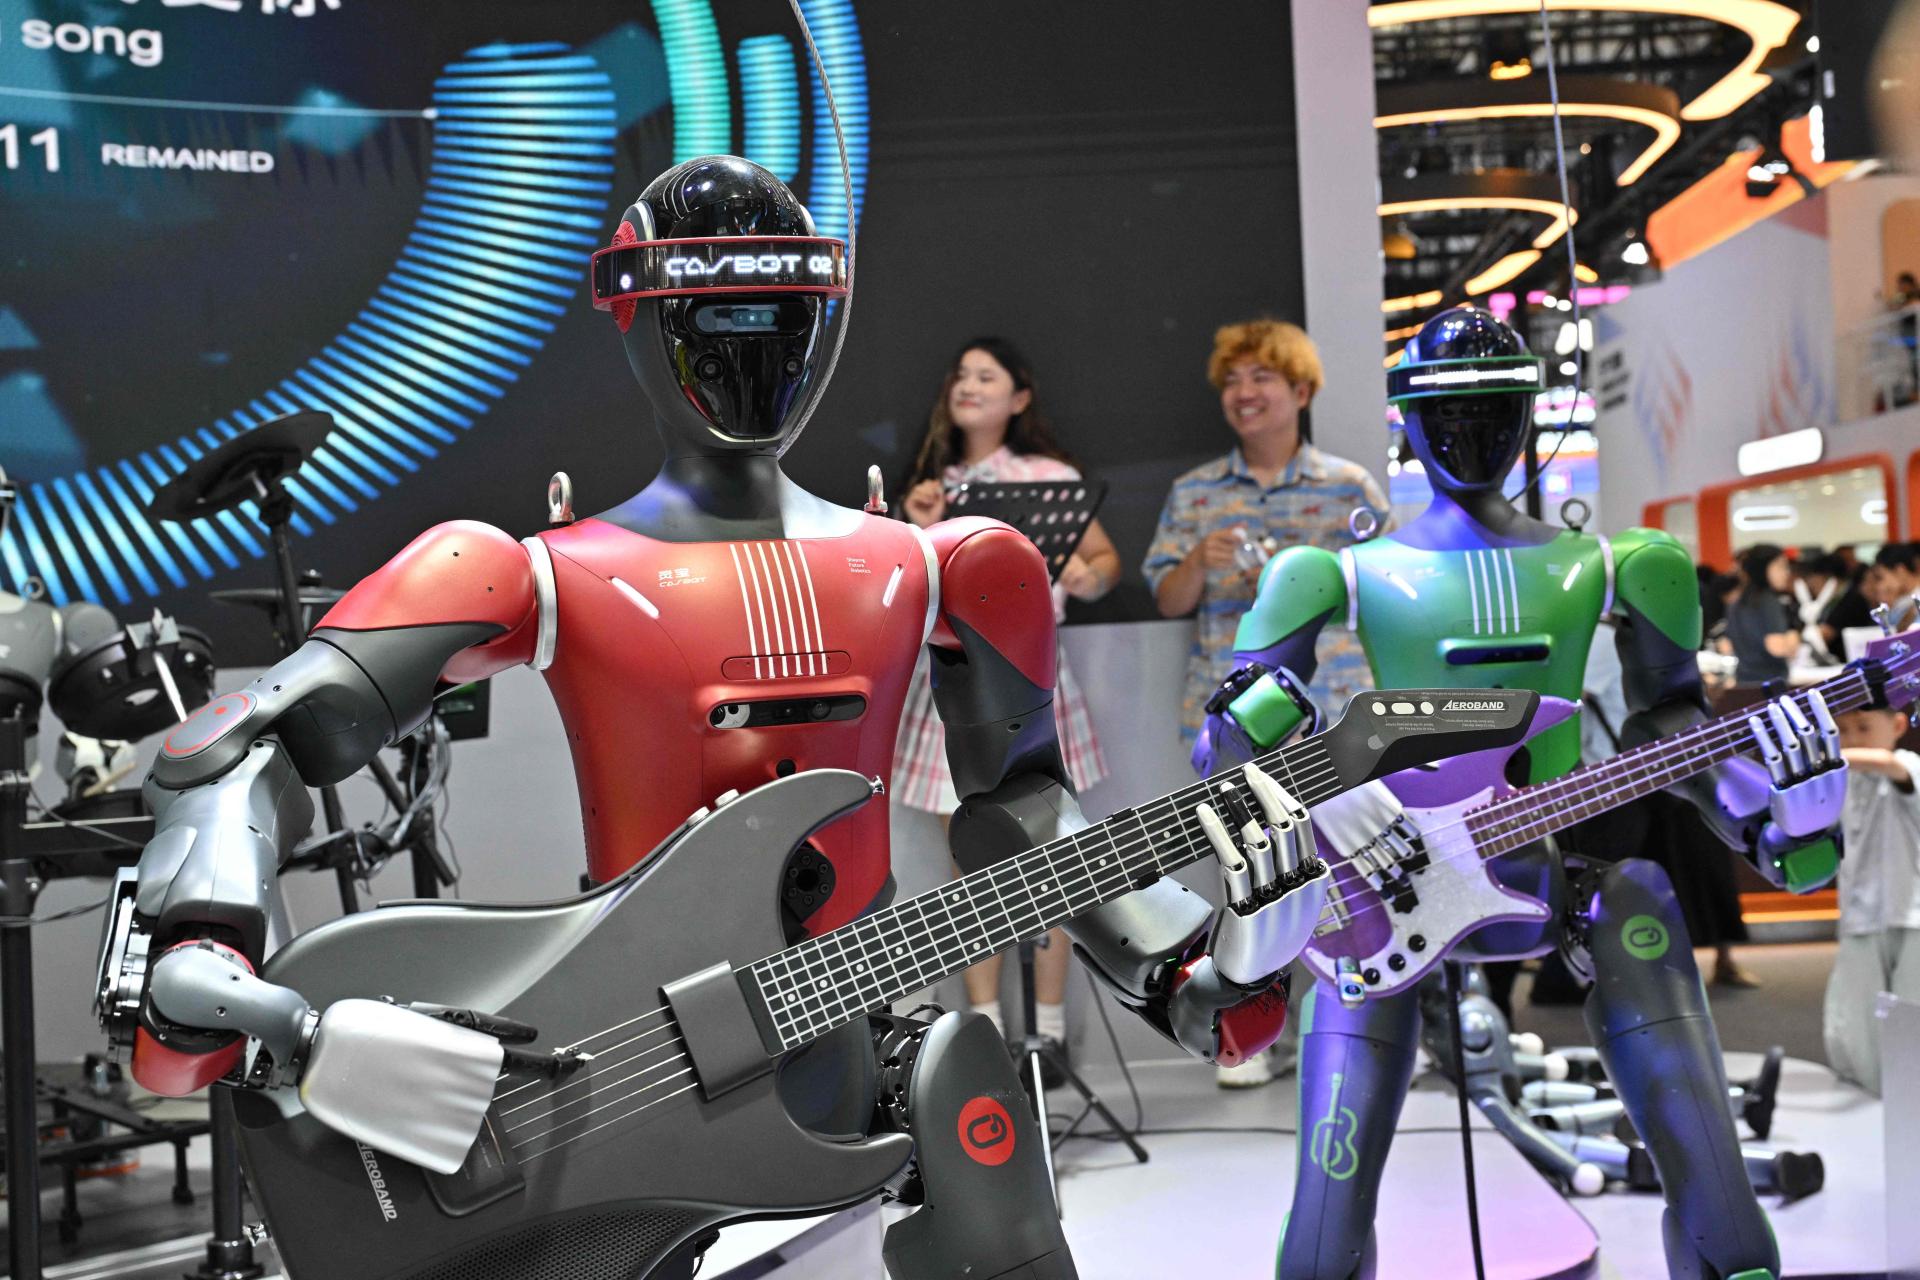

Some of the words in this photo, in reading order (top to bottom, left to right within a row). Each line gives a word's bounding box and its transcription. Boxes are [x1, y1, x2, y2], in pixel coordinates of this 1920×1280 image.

[21, 19, 163, 67] song
[102, 143, 274, 173] REMAINED
[666, 255, 801, 275] CASBOT
[1441, 699, 1506, 711] AEROBAND
